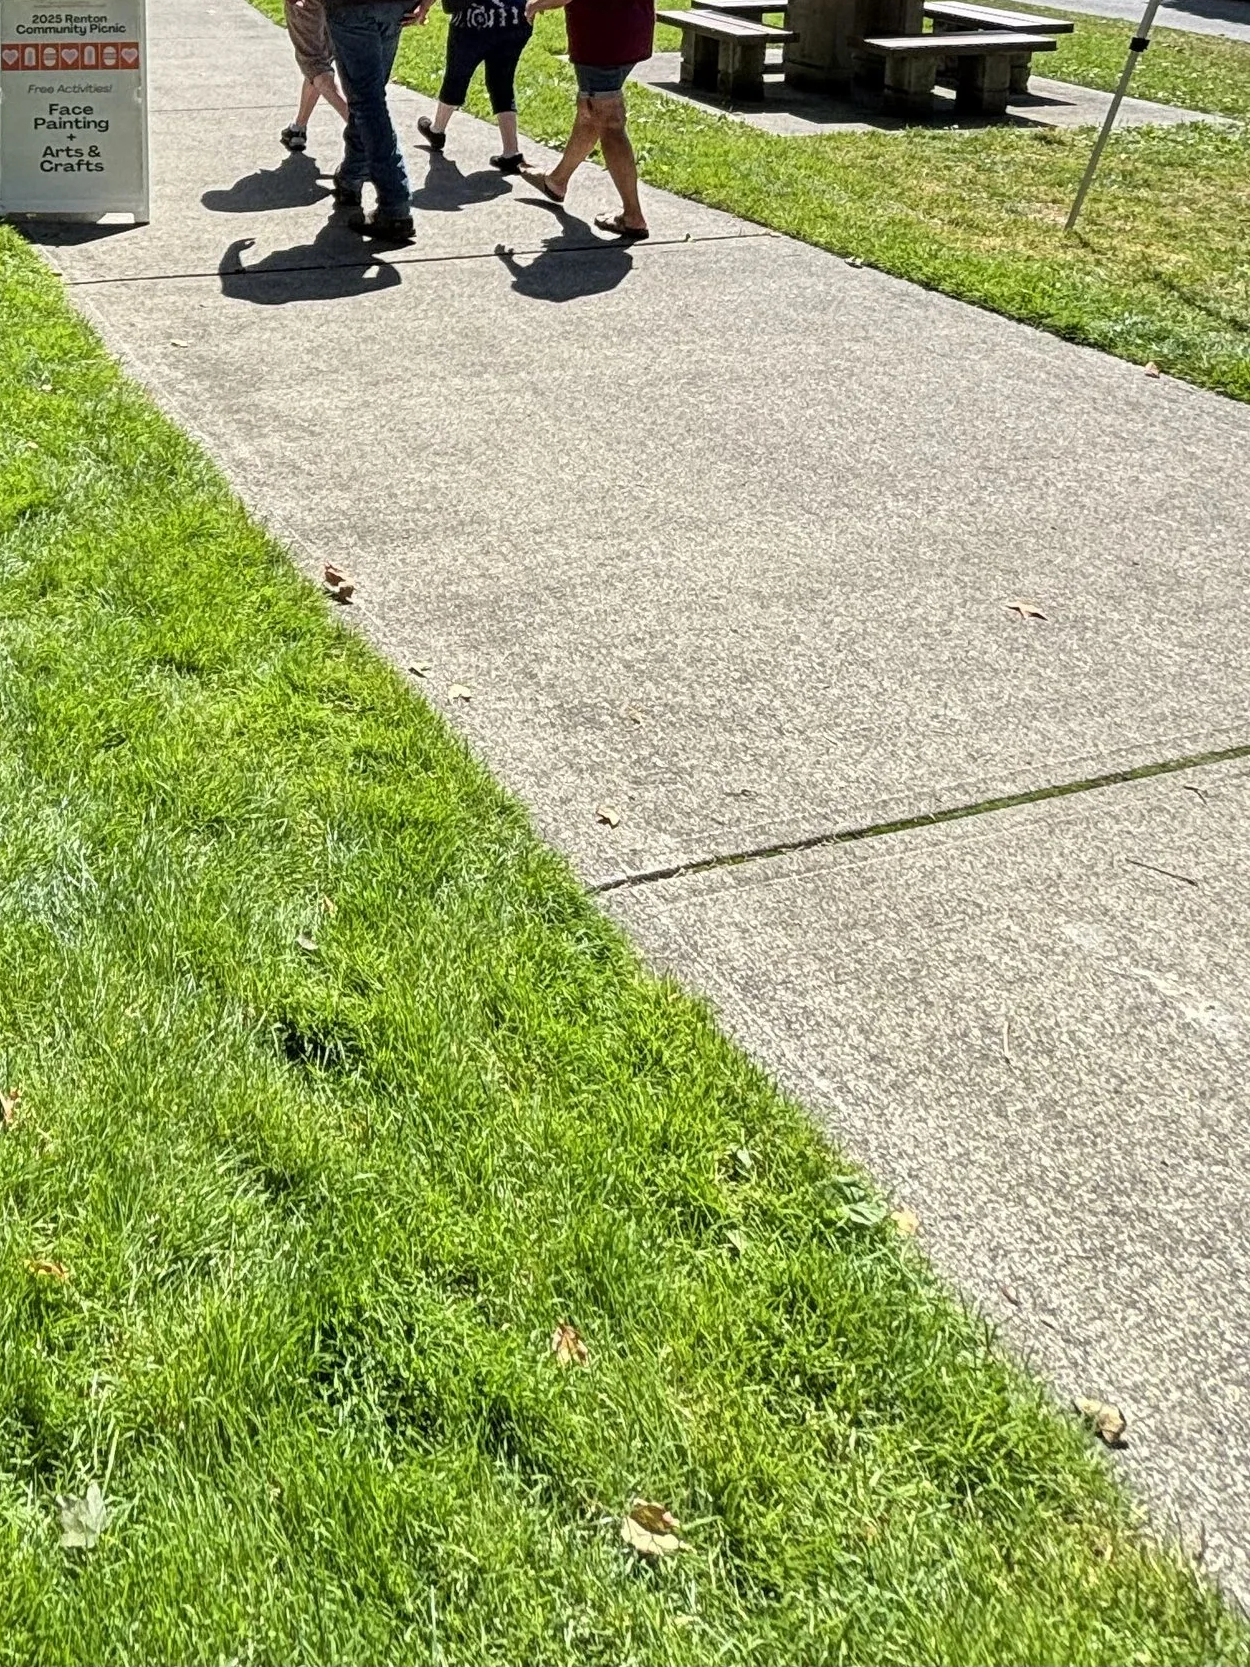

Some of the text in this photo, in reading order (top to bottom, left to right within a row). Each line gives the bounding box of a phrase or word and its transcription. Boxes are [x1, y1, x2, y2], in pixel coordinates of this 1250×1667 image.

[32, 14, 108, 24] 2025 Renton
[16, 23, 127, 36] Community Picnic
[28, 84, 113, 94] Free Activities!
[49, 103, 94, 116] Face
[33, 117, 110, 132] Painting
[67, 133, 76, 141] +
[42, 145, 101, 158] Arts &
[40, 159, 104, 173] Crafts
